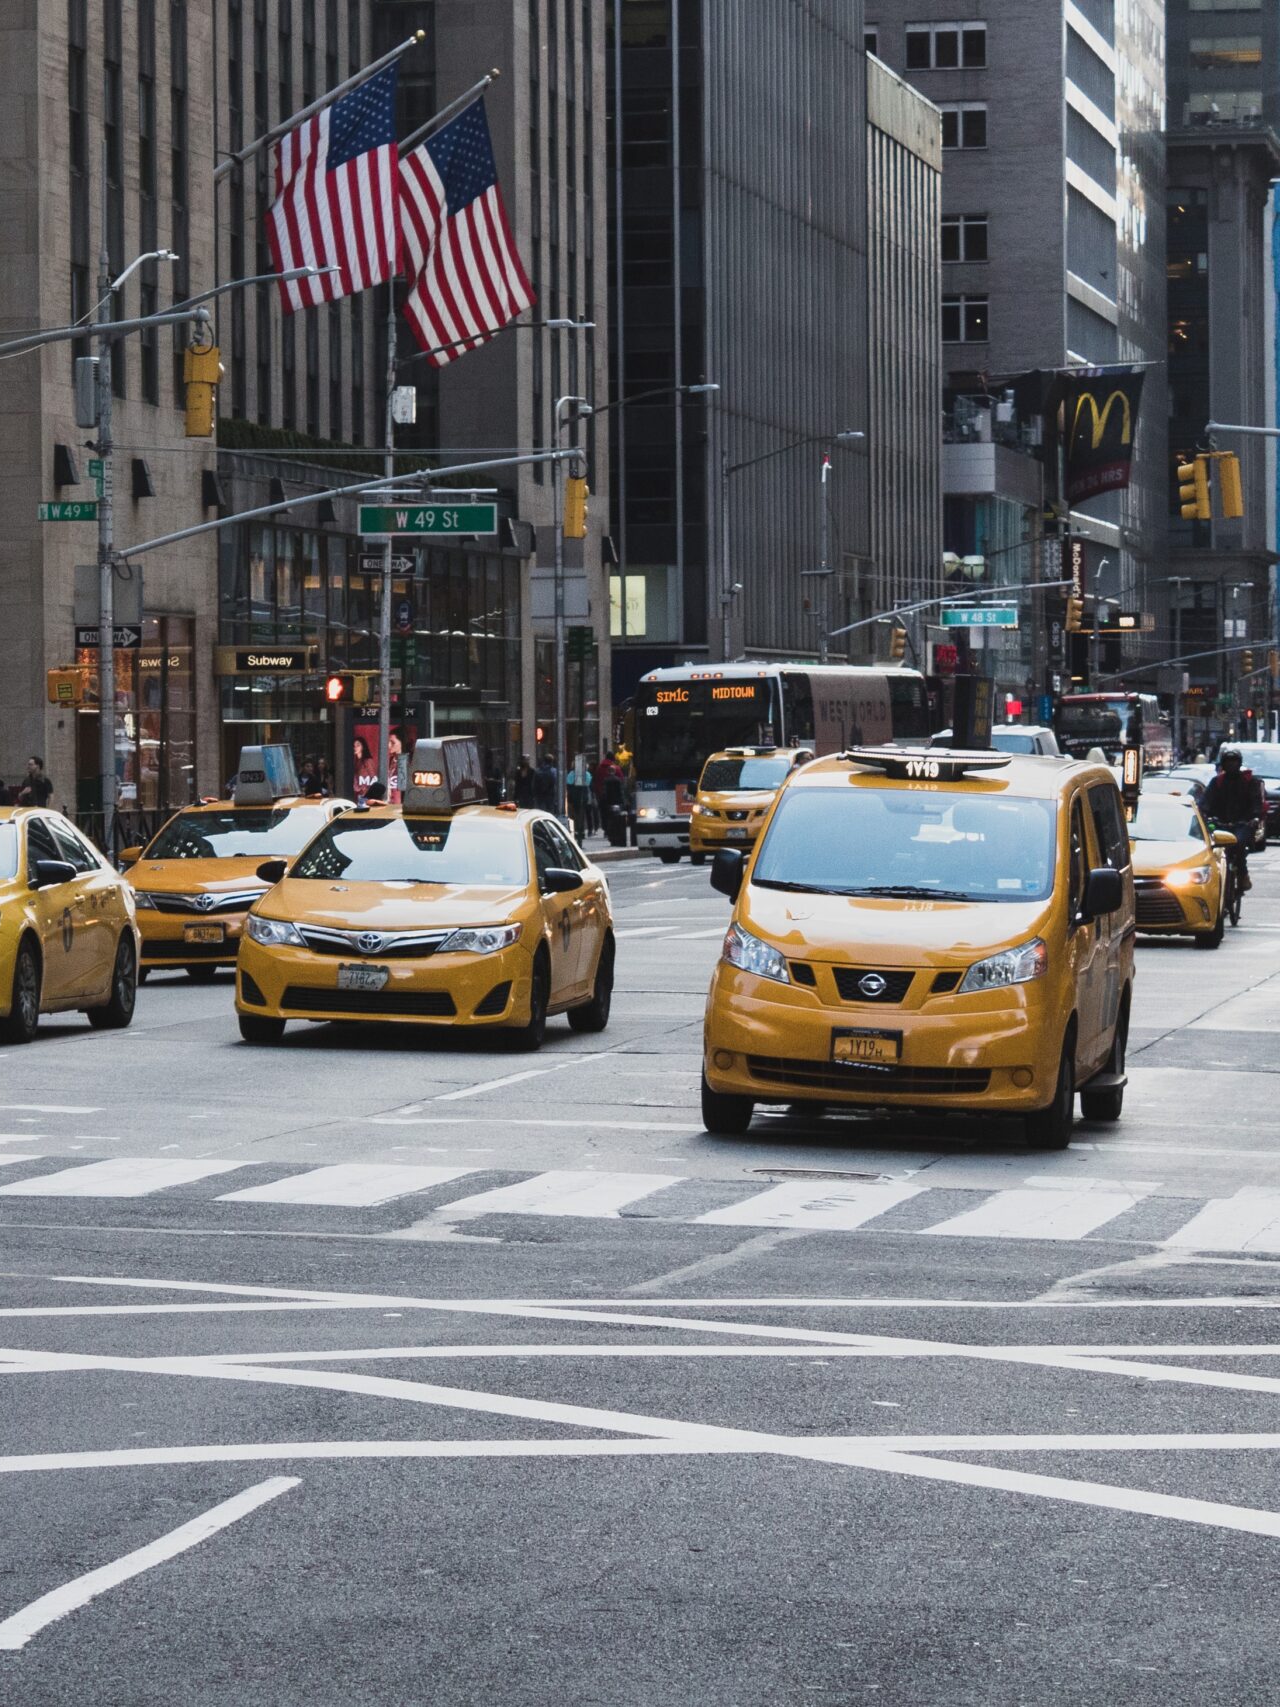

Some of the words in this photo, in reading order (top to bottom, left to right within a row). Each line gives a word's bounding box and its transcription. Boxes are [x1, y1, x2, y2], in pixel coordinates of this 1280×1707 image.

[51, 504, 61, 518] W
[64, 504, 81, 518] 49
[396, 511, 408, 528] W
[414, 511, 435, 528] 49
[442, 511, 459, 528] St
[391, 560, 408, 568] WAY
[1072, 543, 1082, 598] McDonald's
[960, 613, 969, 622] W
[971, 613, 983, 622] 48
[986, 612, 997, 623] St
[84, 633, 97, 642] ON
[113, 633, 132, 642] WAY
[247, 654, 293, 668] Subway
[656, 688, 690, 703] SIM1C
[712, 686, 755, 700] MIDTOWN
[820, 700, 887, 721] WESTWORLD
[906, 761, 939, 778] 1Y19
